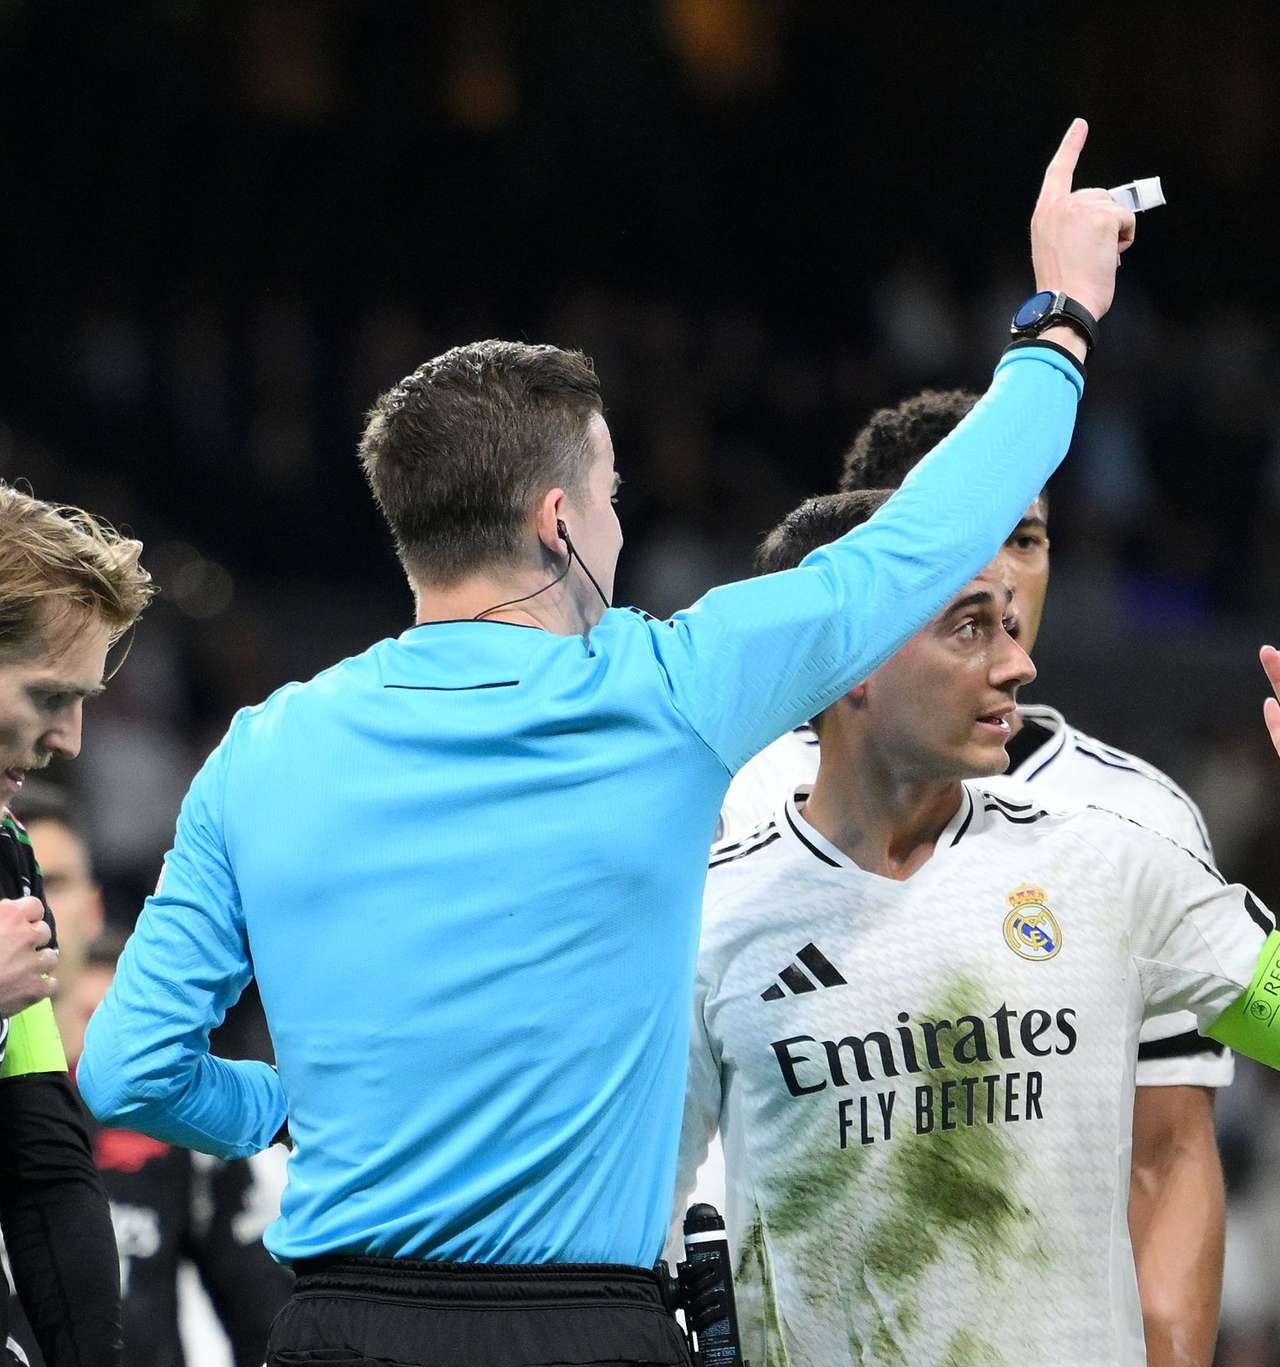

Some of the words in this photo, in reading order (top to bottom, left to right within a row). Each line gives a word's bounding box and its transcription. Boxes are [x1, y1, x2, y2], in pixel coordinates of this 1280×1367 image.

[770, 1001, 1077, 1097] Emirates
[838, 1091, 896, 1149] FLY
[916, 1071, 1043, 1135] BETTER
